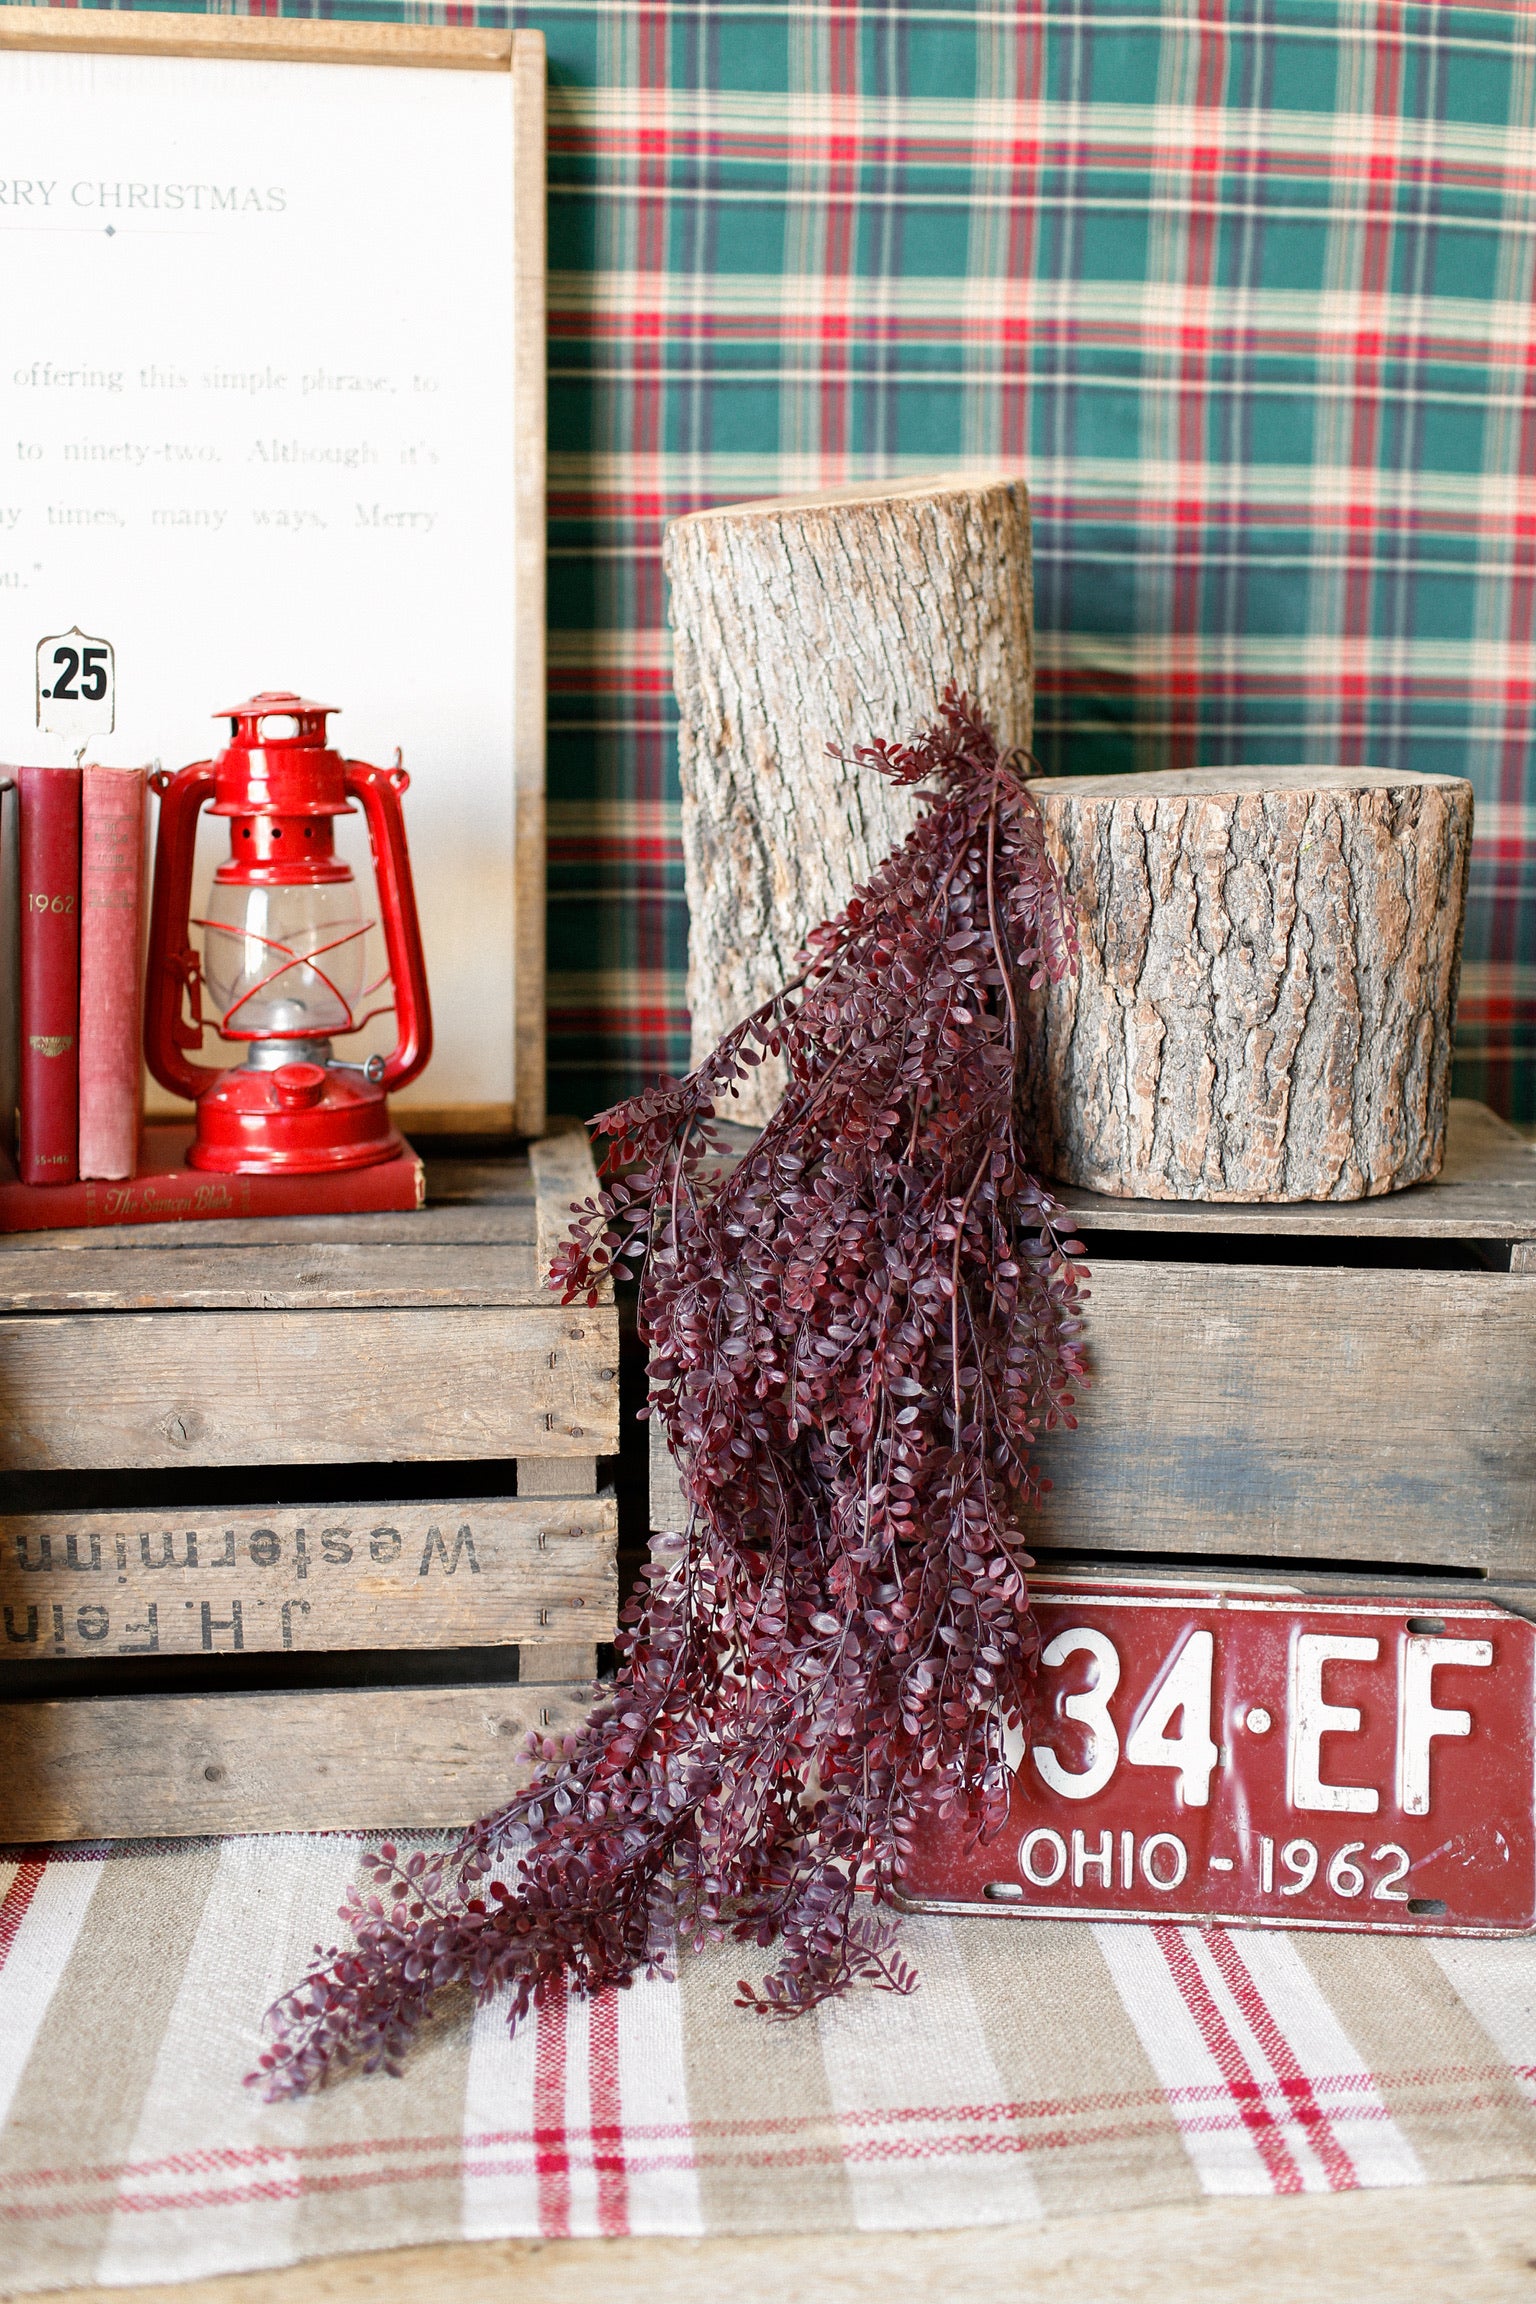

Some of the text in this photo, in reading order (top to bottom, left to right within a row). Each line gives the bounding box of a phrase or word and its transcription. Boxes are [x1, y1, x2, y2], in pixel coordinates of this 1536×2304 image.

[71, 181, 288, 213] CHRISTMAS
[13, 363, 124, 393] offering
[139, 364, 189, 390] this
[200, 367, 288, 396] simple
[412, 374, 440, 393] to
[17, 441, 43, 463] to
[63, 437, 223, 466] ninety-two.
[246, 439, 379, 468] Although
[46, 501, 126, 529] times,
[151, 508, 228, 532] many
[253, 508, 329, 532] ways,
[354, 503, 438, 533] Merry
[42, 647, 107, 701] .25
[29, 893, 75, 914] 1962
[104, 1187, 137, 1215] The
[16, 1522, 481, 1584] Westerminn
[1018, 1827, 1189, 1892] OHIO
[1260, 1834, 1411, 1902] 1962
